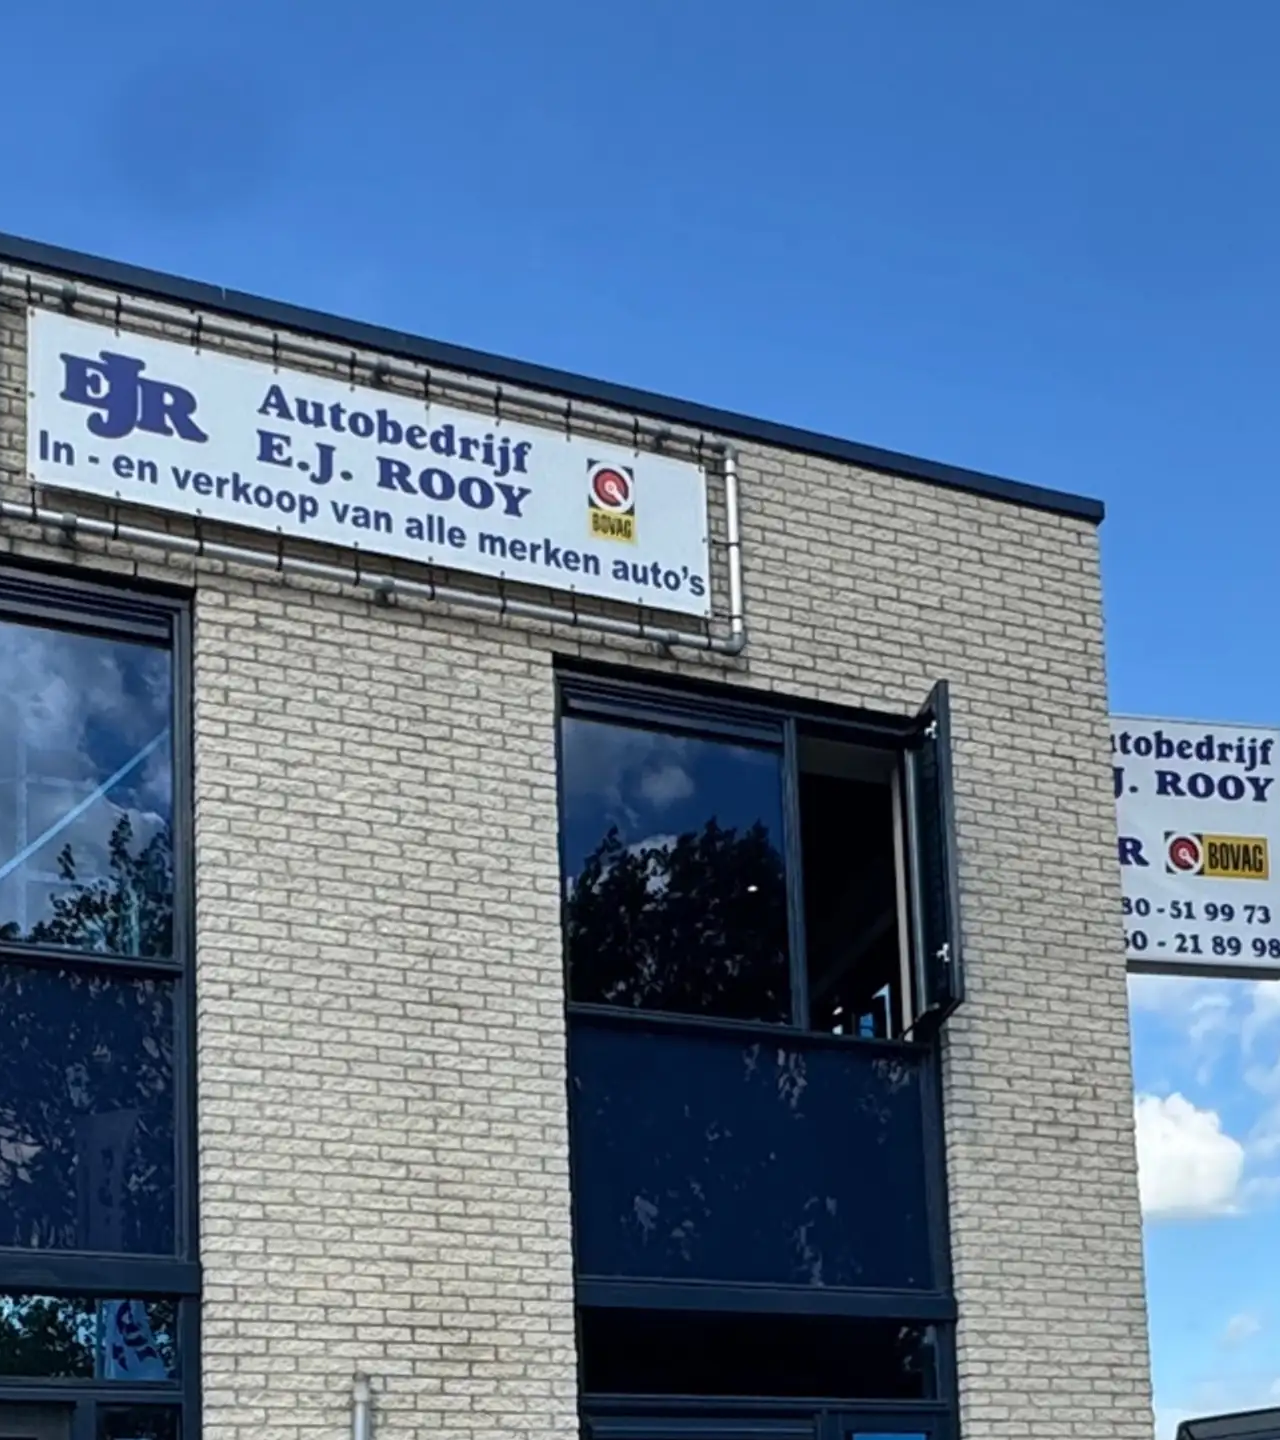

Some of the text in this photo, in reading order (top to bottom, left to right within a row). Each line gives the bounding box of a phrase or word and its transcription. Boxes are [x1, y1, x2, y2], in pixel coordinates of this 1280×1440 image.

[59, 350, 209, 443] EJR
[256, 384, 532, 477] Autobedrijf
[256, 429, 532, 518] E.J. ROOY
[39, 429, 75, 466] In
[112, 454, 159, 485] en
[171, 466, 320, 524] verkoop
[330, 500, 393, 534] van
[405, 513, 467, 549] alle
[478, 531, 601, 576] merken
[612, 558, 706, 597] auto's
[592, 512, 632, 539] BOVAG
[1154, 768, 1276, 803] ROOY
[1208, 842, 1264, 873] BOVAG
[1169, 899, 1197, 920] 51
[1204, 901, 1235, 923] 99
[1243, 904, 1271, 925] 73
[1174, 931, 1203, 955] 21
[1212, 935, 1242, 957] 89
